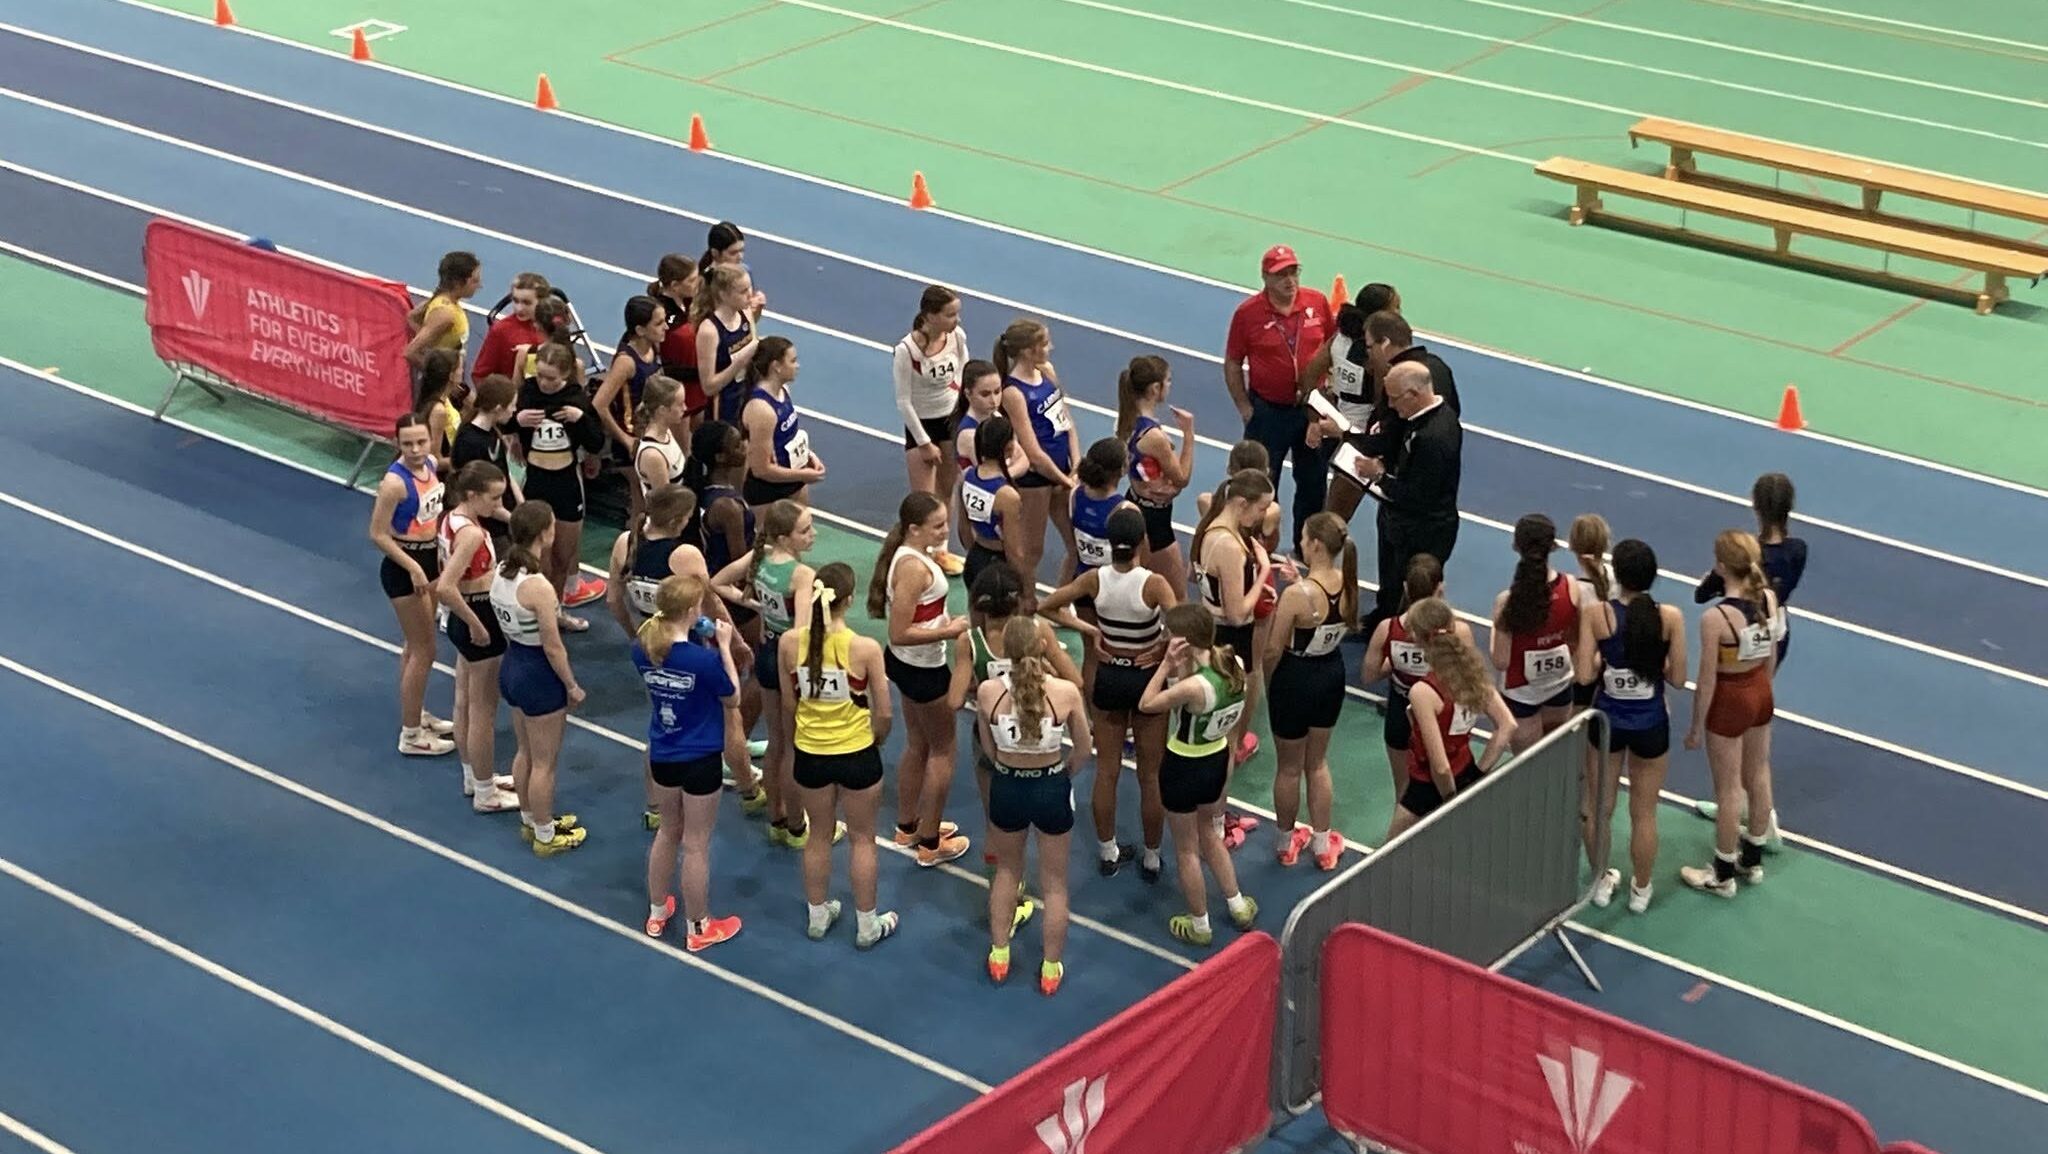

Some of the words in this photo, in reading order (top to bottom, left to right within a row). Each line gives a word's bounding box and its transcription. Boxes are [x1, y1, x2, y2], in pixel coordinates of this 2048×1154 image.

[247, 287, 340, 336] ATHLETICS
[249, 313, 282, 341] FOR
[287, 325, 381, 378] EVERYONE,
[250, 339, 367, 397] EVERYWHERE
[929, 362, 955, 379] 134
[536, 426, 565, 440] 113
[964, 492, 986, 512] 123
[1078, 538, 1105, 558] 365
[634, 589, 656, 603] 15
[1400, 651, 1424, 665] 15
[1533, 656, 1565, 673] 158
